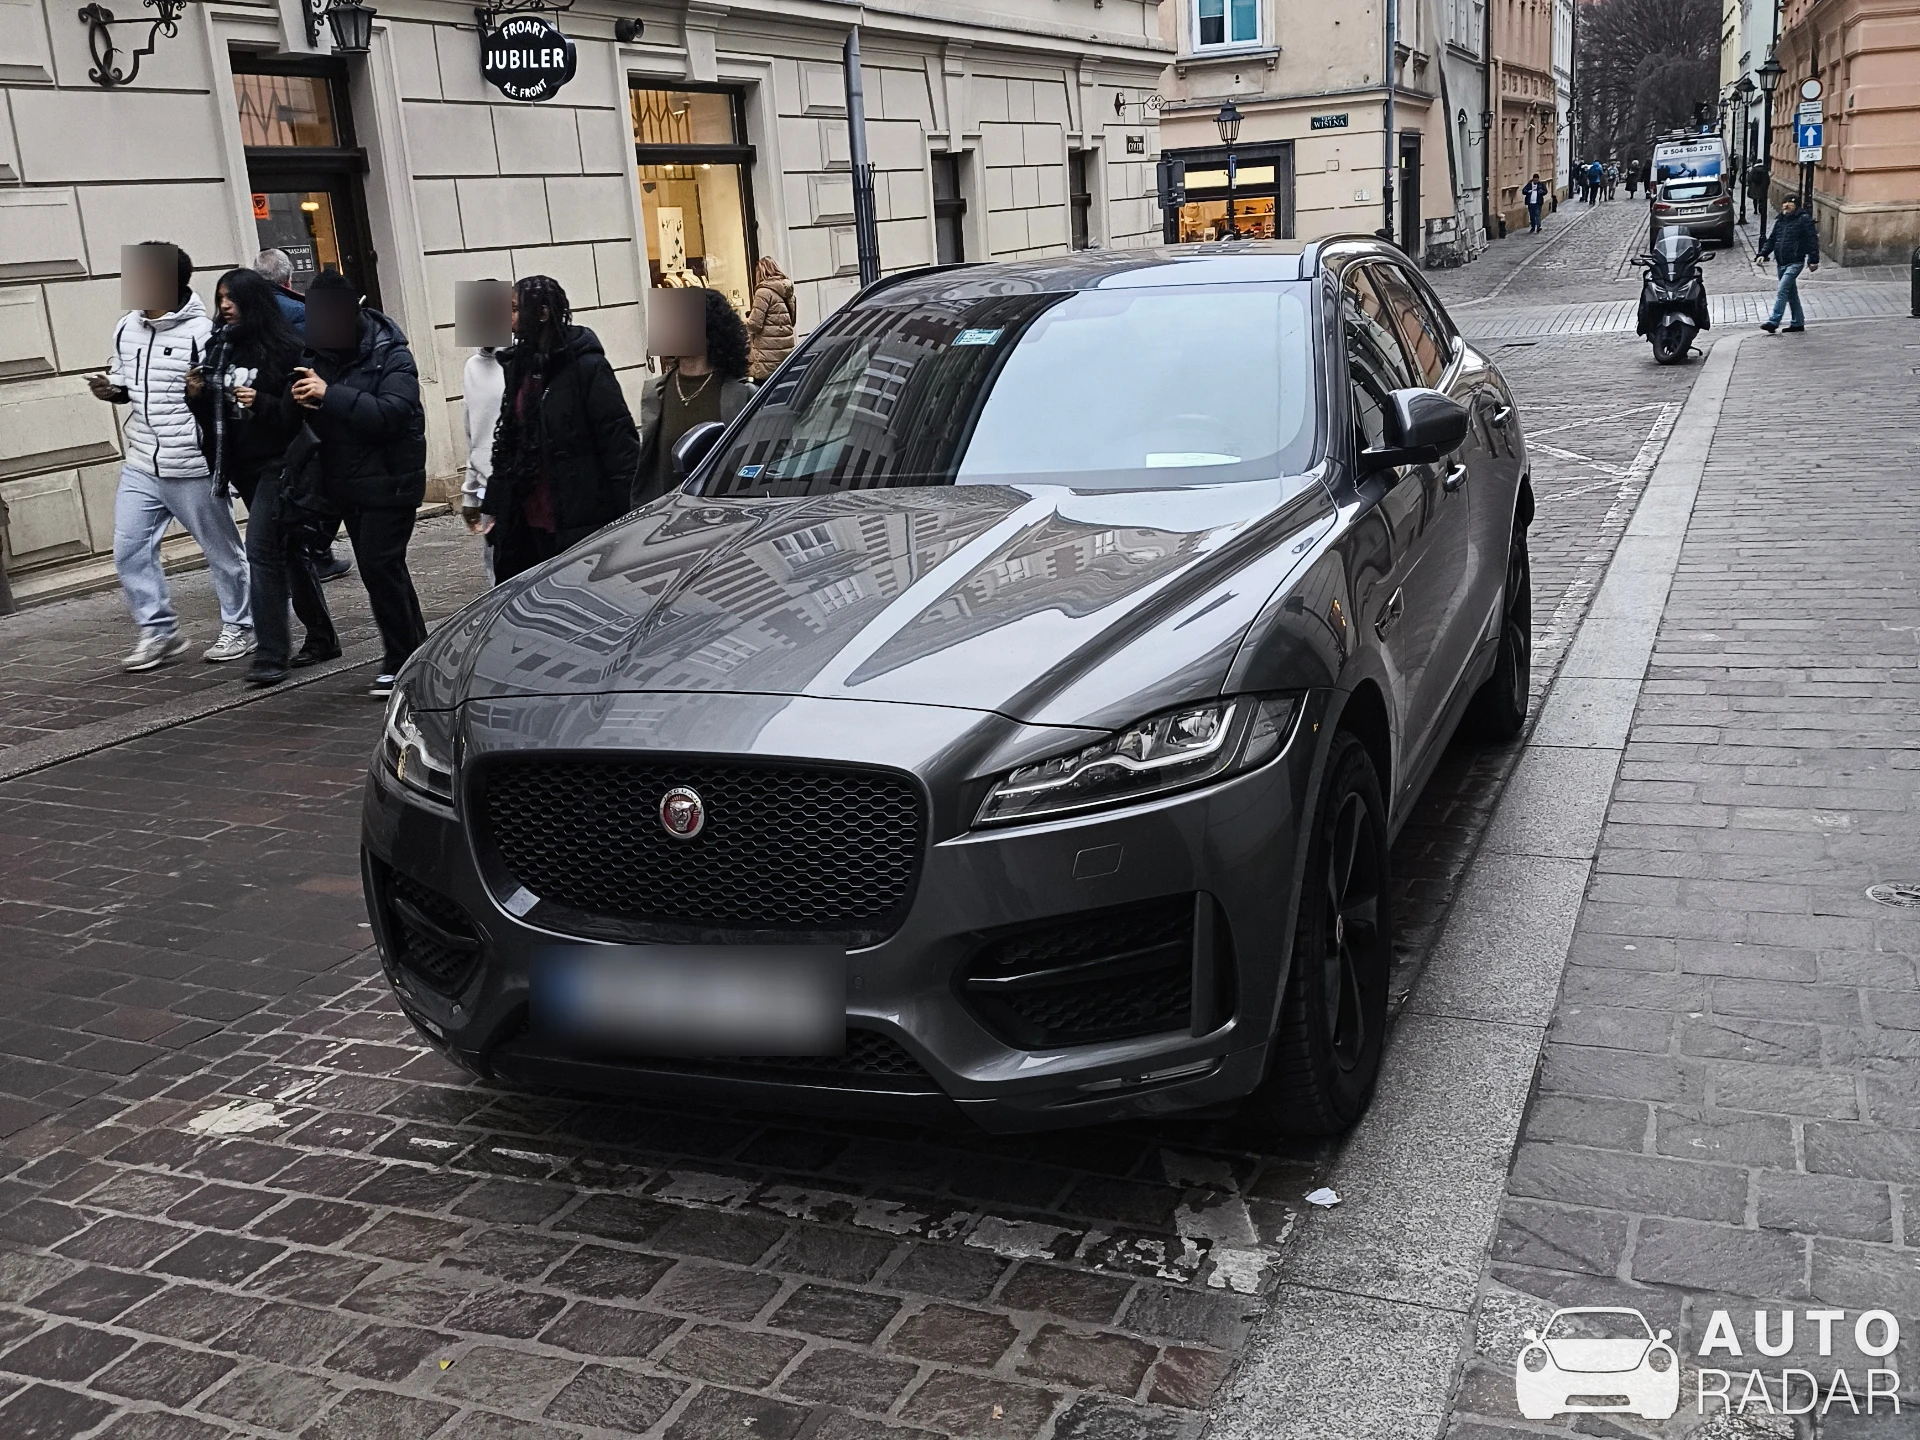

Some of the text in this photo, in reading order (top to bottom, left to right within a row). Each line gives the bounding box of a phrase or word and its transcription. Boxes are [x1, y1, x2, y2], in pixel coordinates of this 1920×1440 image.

[502, 20, 549, 40] FROART
[485, 48, 564, 70] JUBILER
[519, 78, 548, 98] FRONT
[1670, 147, 1684, 155] 504
